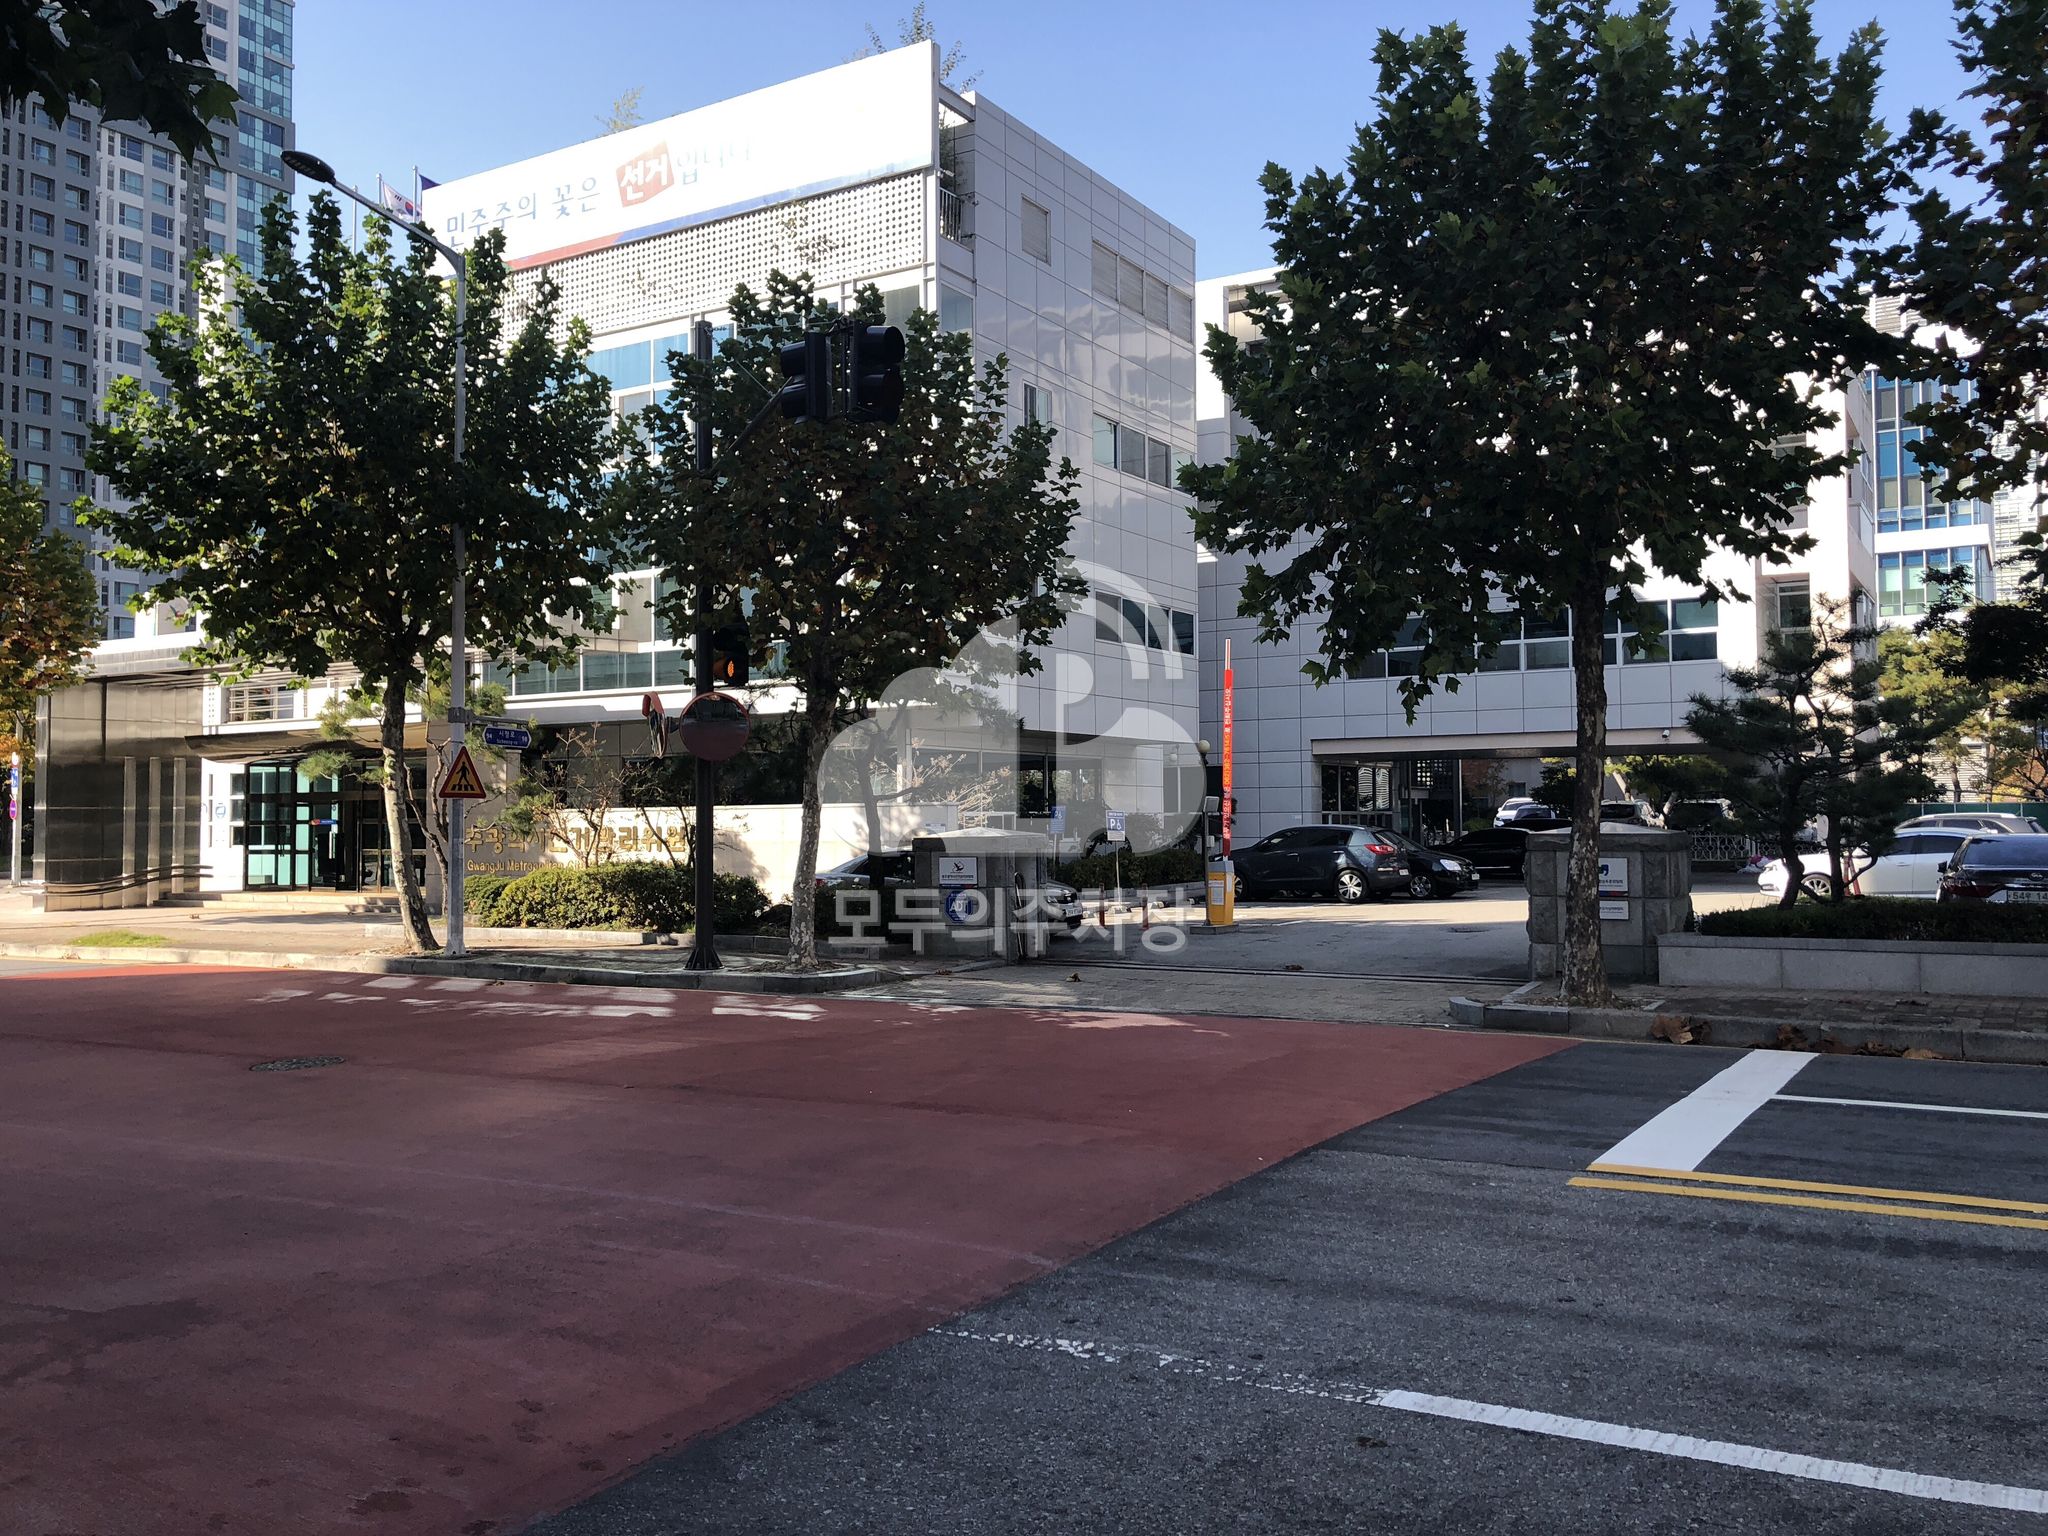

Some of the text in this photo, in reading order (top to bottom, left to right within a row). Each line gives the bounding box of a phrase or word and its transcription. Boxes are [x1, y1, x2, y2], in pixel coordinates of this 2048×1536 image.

[447, 192, 536, 248] 민주주의
[551, 177, 601, 219] 꽃은
[950, 900, 968, 911] ADT
